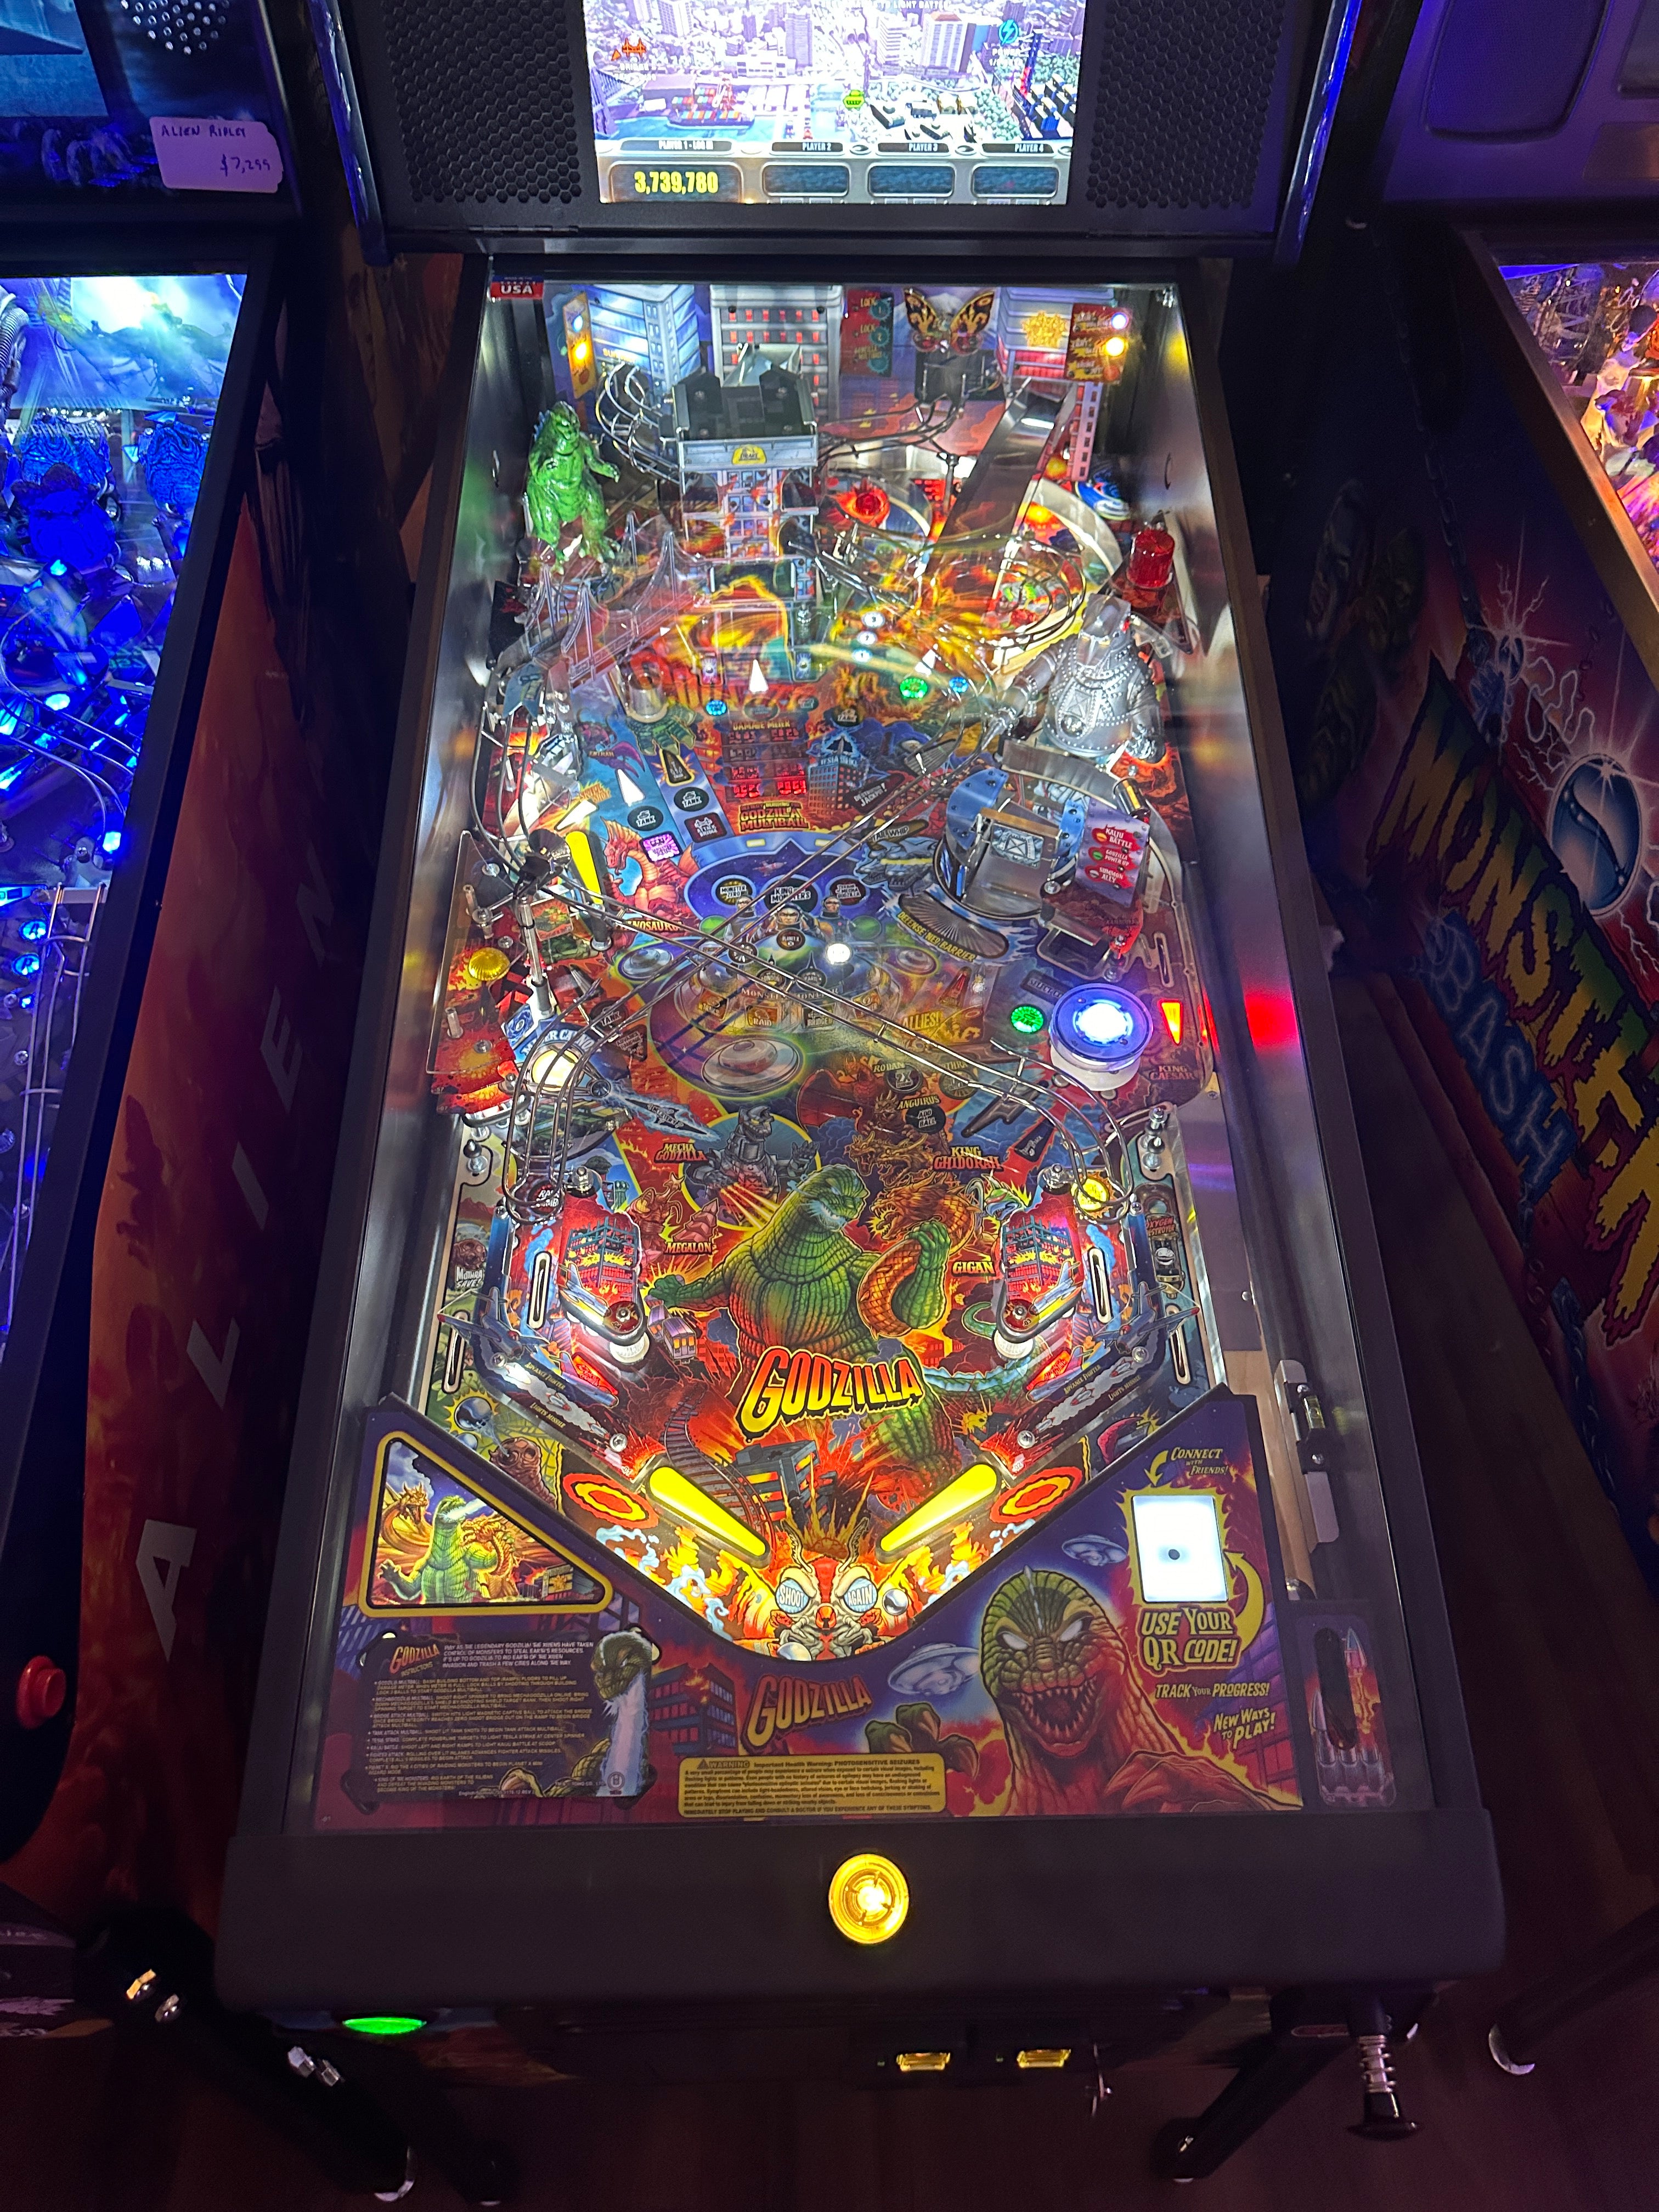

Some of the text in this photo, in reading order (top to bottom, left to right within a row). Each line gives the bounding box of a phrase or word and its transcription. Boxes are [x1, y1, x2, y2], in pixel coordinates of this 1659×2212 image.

[161, 124, 246, 138] ALIEN RIPLEY
[658, 140, 682, 150] PLAYER
[802, 143, 825, 151] PLAYER
[909, 143, 938, 152] PLAYER 3
[1014, 143, 1044, 152] PLAYER 4
[220, 154, 270, 177] $7,299
[633, 171, 719, 195] 3,739,780
[500, 284, 533, 295] USA
[681, 795, 703, 808] TANK
[637, 815, 656, 827] TANK
[740, 808, 802, 822] GODZILLA
[740, 818, 810, 832] MULTIBALL
[888, 825, 910, 839] WHIP
[1105, 827, 1124, 838] KAIJU
[1109, 834, 1133, 850] BATTLE
[1104, 856, 1130, 867] POWER UP
[1105, 849, 1128, 860] GODZILLA
[1099, 867, 1124, 880] SUMMON
[1101, 874, 1118, 885] ALLY
[719, 885, 747, 895] MONSTER
[897, 911, 928, 935] DEFENSE
[941, 935, 976, 962] BARRIER
[601, 1011, 622, 1027] TANK
[807, 1018, 828, 1026] BRIDGE
[902, 1011, 943, 1031] ALLIES!
[873, 1062, 905, 1073] RODAN
[1158, 1065, 1187, 1074] KING
[1150, 1071, 1196, 1081] CAESAR
[898, 1096, 940, 1110] ANGUIRUS
[918, 1109, 933, 1119] ADD
[918, 1117, 937, 1128] BALL
[663, 1143, 695, 1153] MECHA
[951, 1147, 981, 1158] KING
[654, 1150, 708, 1161] GODZILLA
[933, 1156, 1002, 1170] GHIDORAH
[664, 1241, 713, 1254] MEGALON
[456, 1266, 484, 1281] MOTHRA
[953, 1261, 995, 1276] GIGAN
[456, 1278, 484, 1290] SAVE!
[524, 1361, 546, 1379] ADVANCE
[1063, 1379, 1083, 1395] ADVANCE
[1082, 1364, 1101, 1382] FIGHTER
[741, 1347, 927, 1436] GODZILLA
[530, 1402, 566, 1428] LIGHTS MISSILE
[1170, 1446, 1223, 1460] CONNECT
[1189, 1463, 1229, 1477] FRIENDS!
[779, 1584, 873, 1608] SHOOT AGAIN
[1141, 1607, 1234, 1636] USE YOUR
[390, 1644, 440, 1674] GODZILLA
[1143, 1636, 1237, 1672] QR CODE!
[1155, 1682, 1271, 1698] TRACK YOUR PROGRESS!
[746, 1674, 872, 1748] GODZILLA
[1214, 1712, 1239, 1732] NEW
[1221, 1711, 1276, 1750] TO PLAY!
[709, 1760, 750, 1769] WARNING
